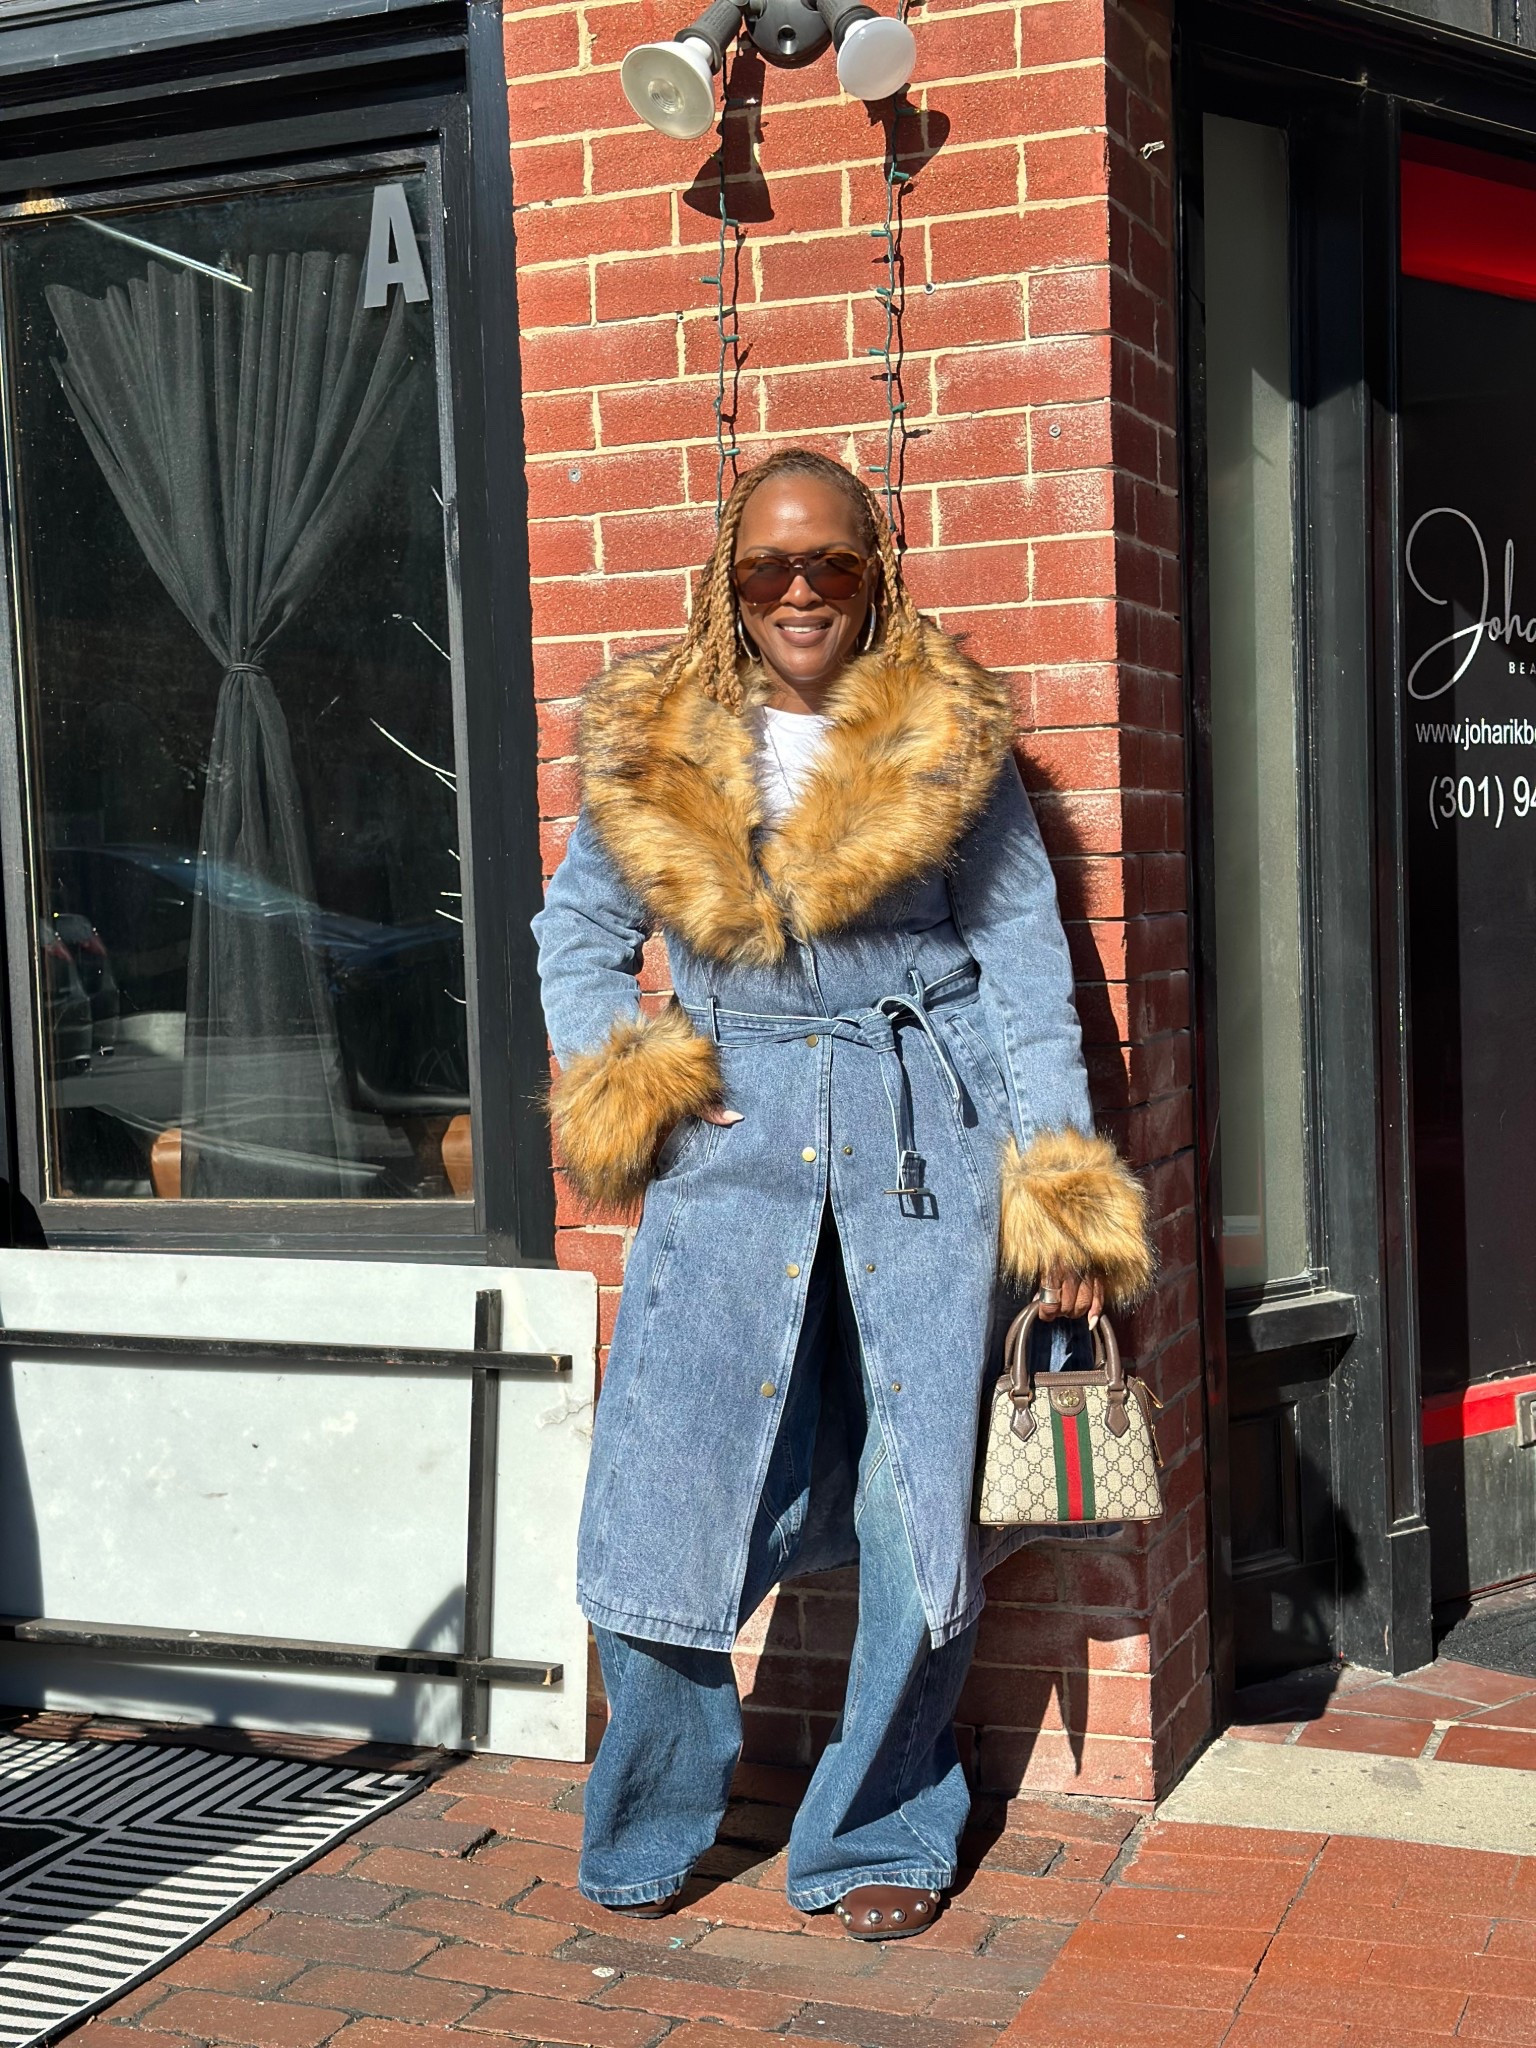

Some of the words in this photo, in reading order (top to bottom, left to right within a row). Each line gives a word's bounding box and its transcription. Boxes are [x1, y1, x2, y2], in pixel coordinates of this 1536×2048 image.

[364, 183, 430, 309] A
[1415, 717, 1536, 751] www.joharikb
[1429, 775, 1505, 830] (301)
